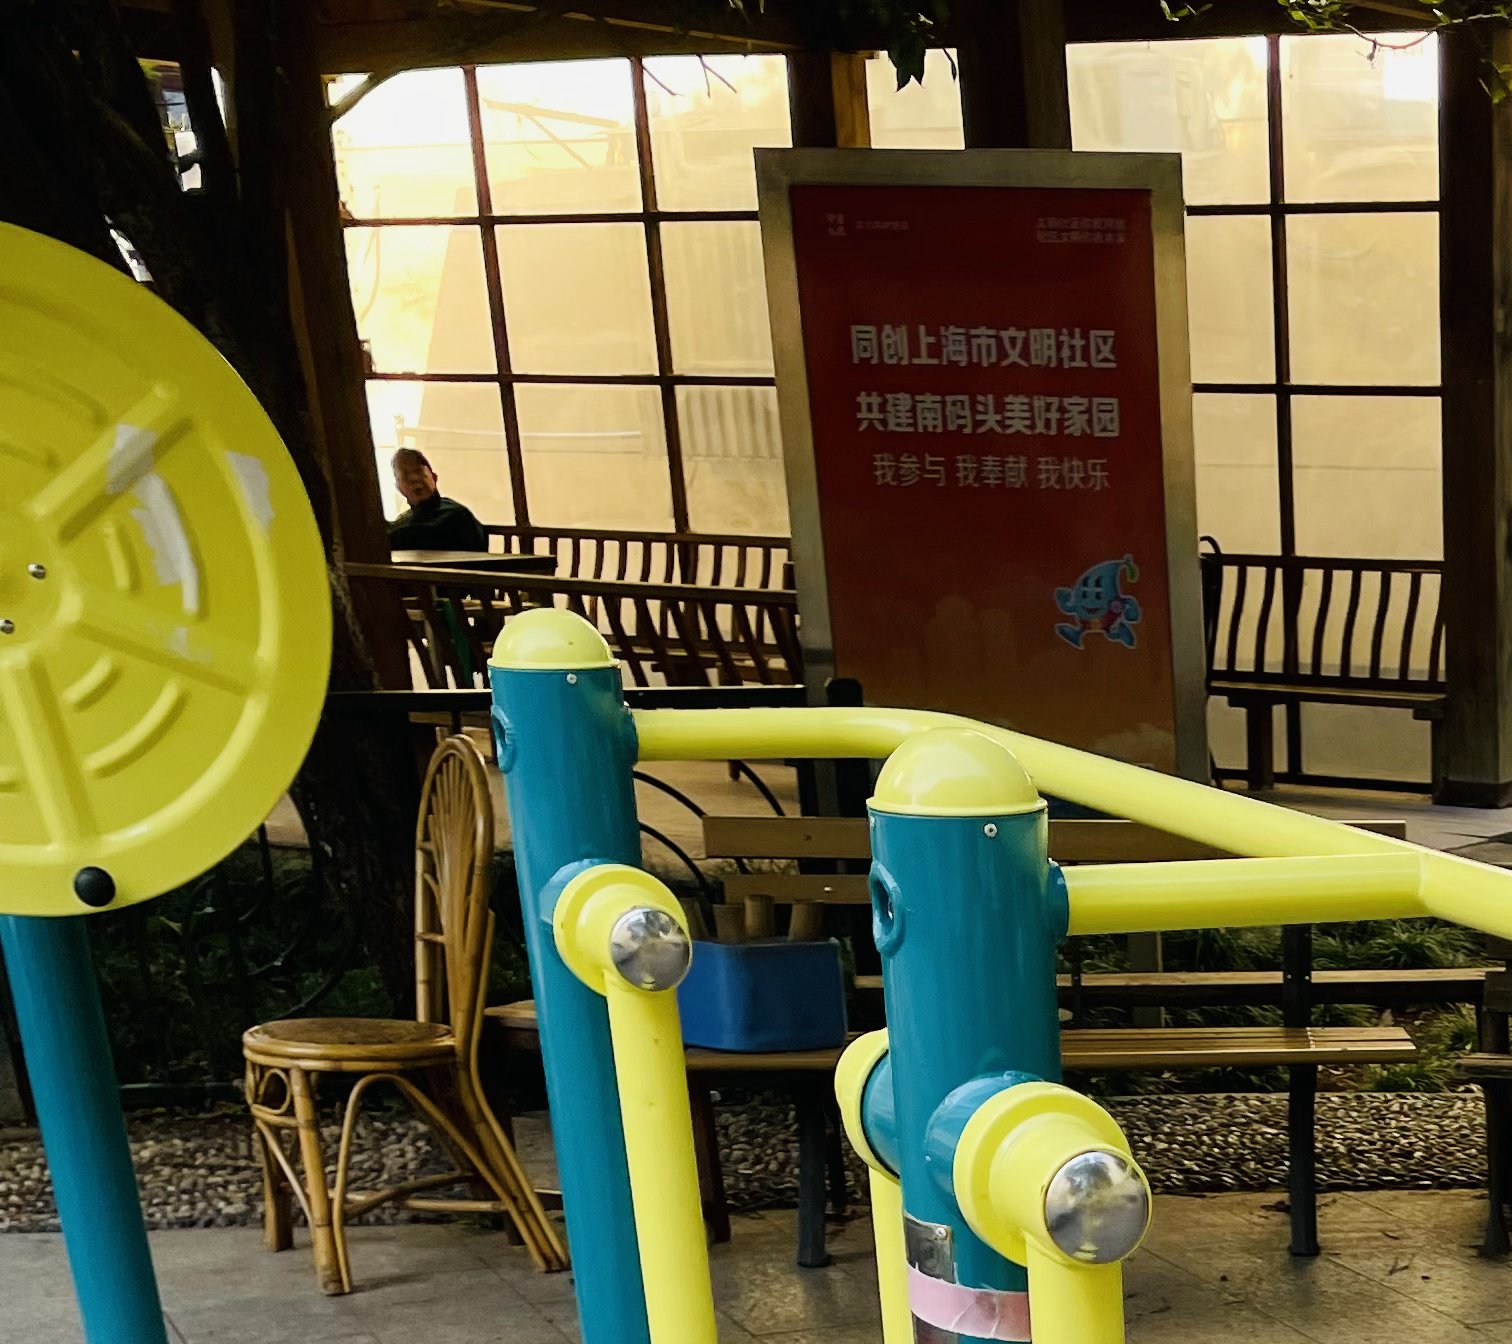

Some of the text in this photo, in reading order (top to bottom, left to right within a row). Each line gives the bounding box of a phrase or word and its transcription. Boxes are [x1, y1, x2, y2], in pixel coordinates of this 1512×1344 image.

[849, 324, 1118, 369] 同创上海市文明社区
[856, 391, 1121, 437] 共建南码头美好家园
[872, 452, 1111, 491] 我参与 我奉献 我快乐
